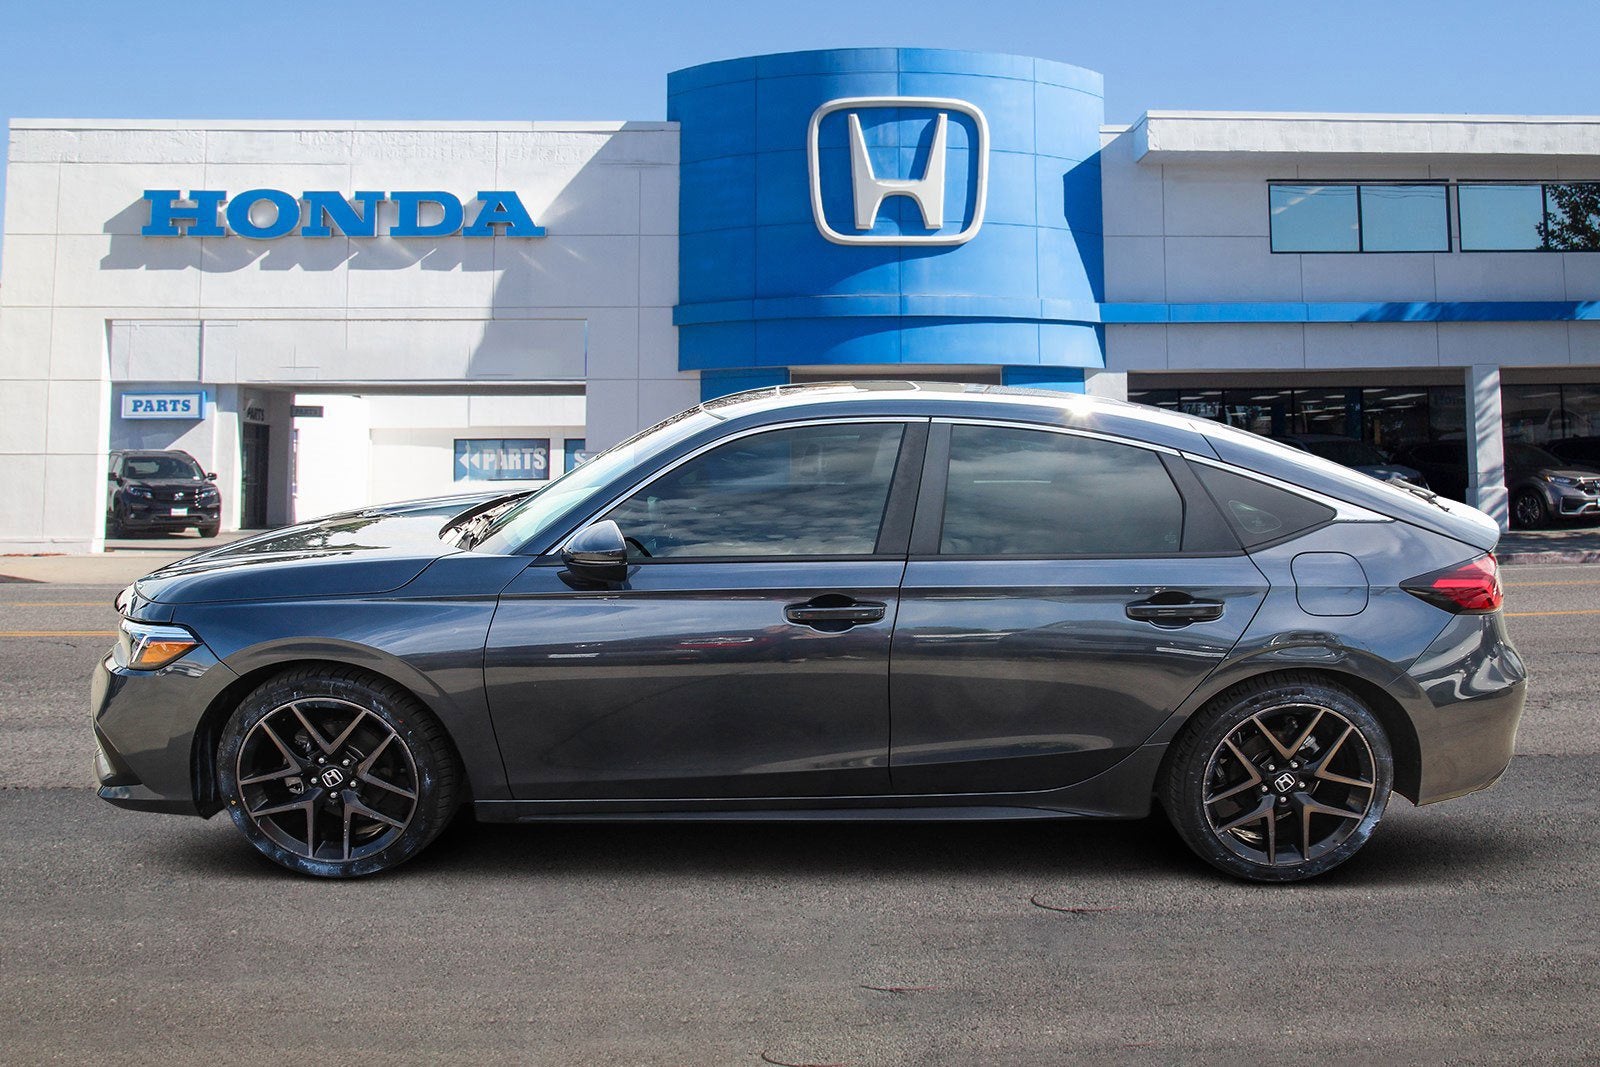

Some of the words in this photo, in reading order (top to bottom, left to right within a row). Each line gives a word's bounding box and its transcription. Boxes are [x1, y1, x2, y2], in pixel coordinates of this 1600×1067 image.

[141, 188, 547, 240] HONDA
[131, 399, 192, 413] PARTS
[482, 447, 547, 471] PARTS
